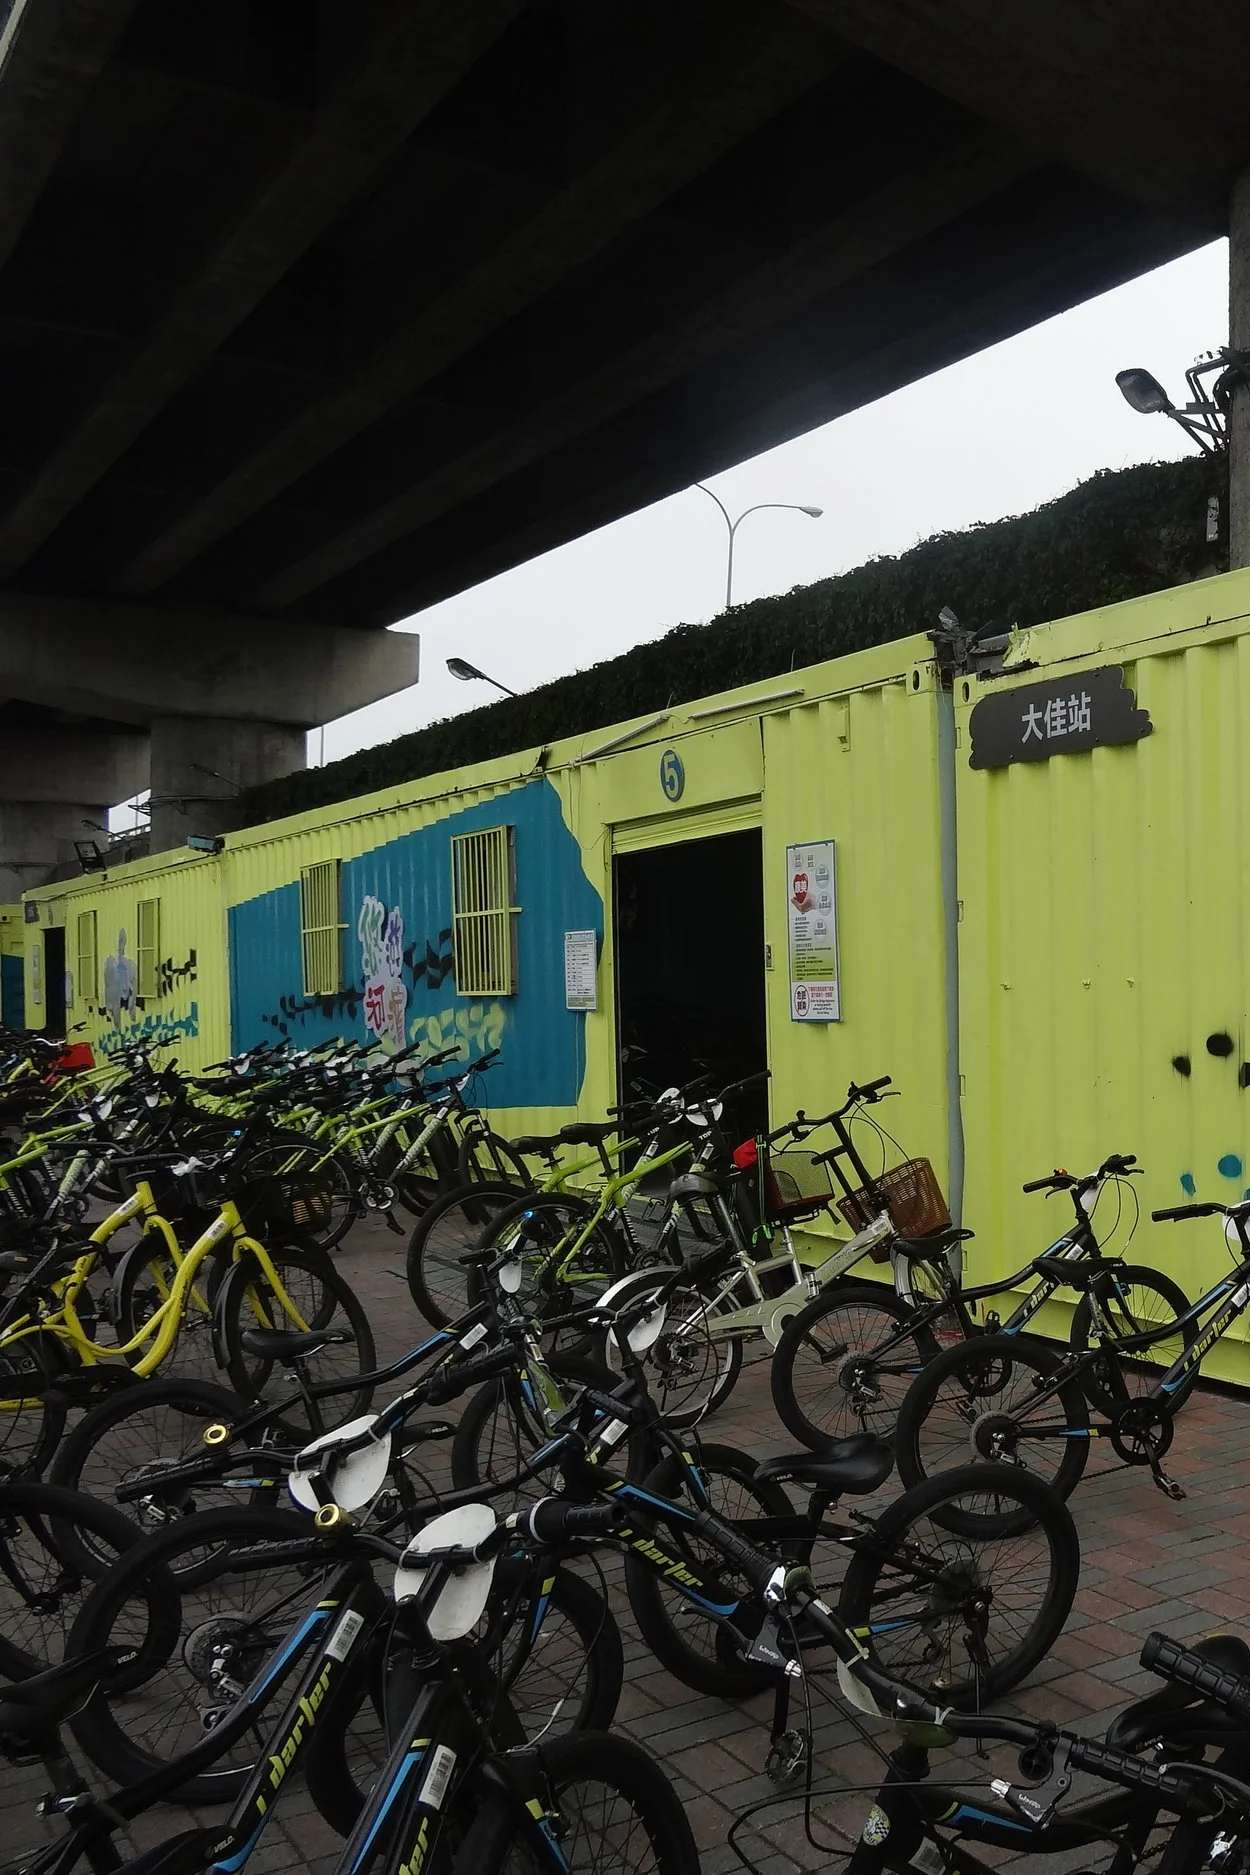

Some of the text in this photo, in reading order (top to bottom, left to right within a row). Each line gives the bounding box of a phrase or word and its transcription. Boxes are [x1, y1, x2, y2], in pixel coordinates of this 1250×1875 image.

[1021, 691, 1092, 744] 大佳站
[663, 753, 679, 799] 5
